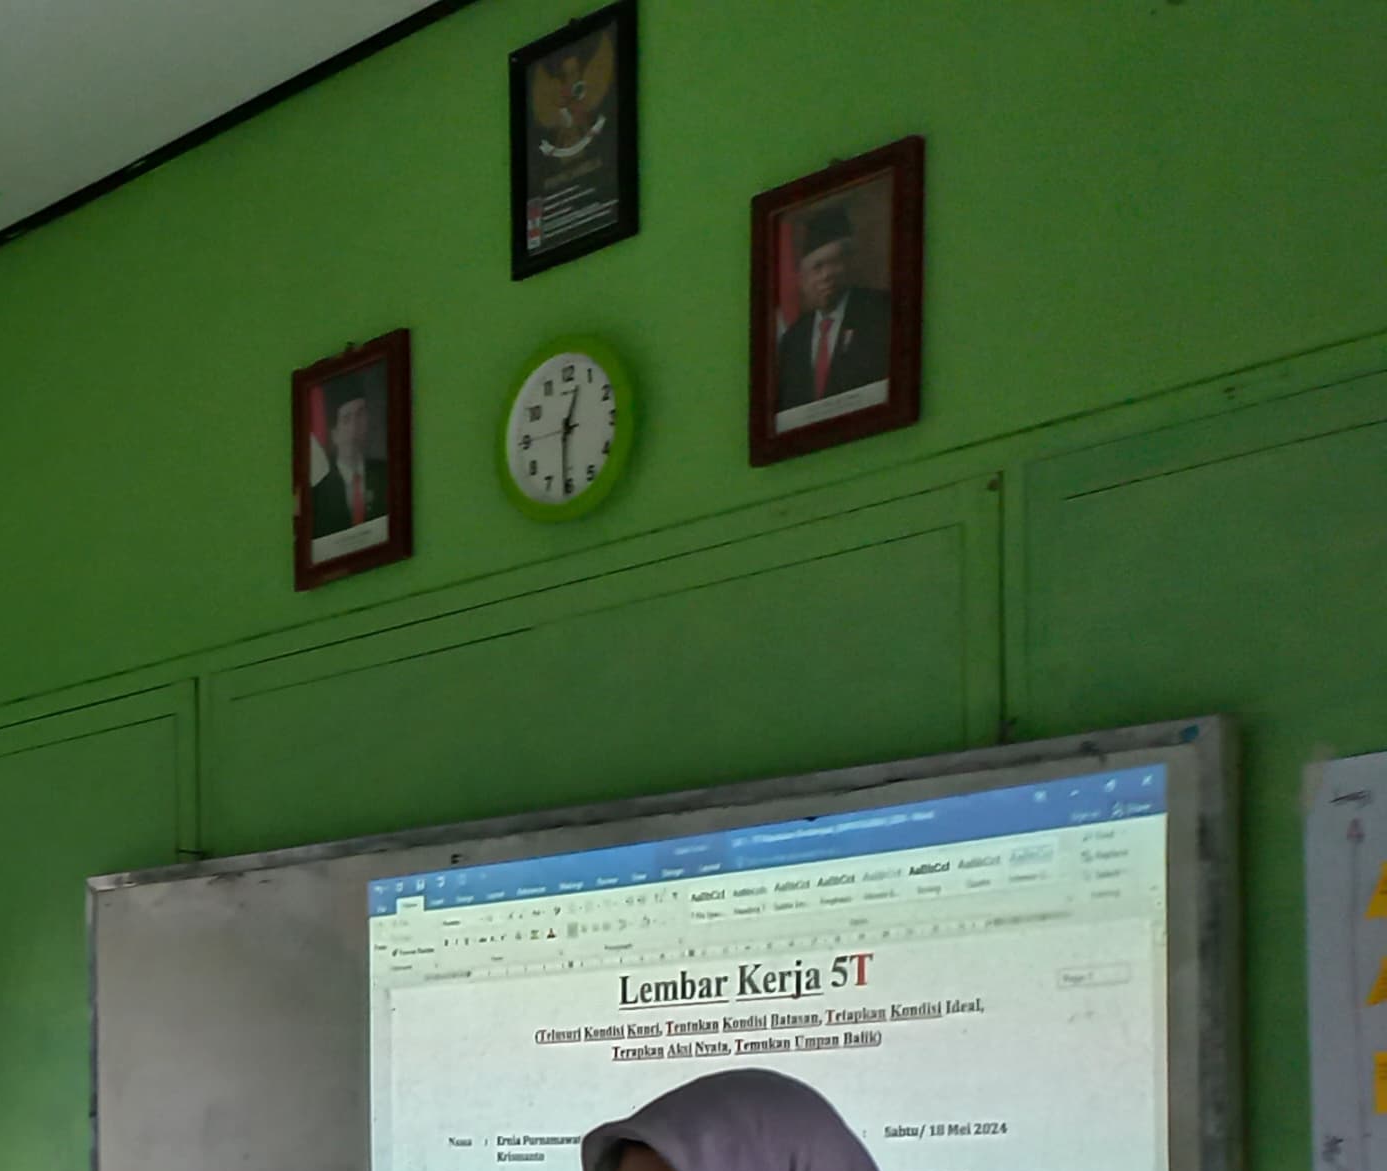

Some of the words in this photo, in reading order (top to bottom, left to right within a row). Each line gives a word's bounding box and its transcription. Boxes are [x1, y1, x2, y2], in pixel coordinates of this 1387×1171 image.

[619, 971, 728, 1008] Lembar
[737, 960, 822, 999] Kerja
[831, 953, 875, 988] 5T
[584, 1024, 625, 1041] Kondisi
[665, 1019, 719, 1036] Tentukan
[723, 1015, 767, 1032] Kondisi
[825, 1008, 887, 1025] Tetapkan
[890, 1001, 942, 1021] Kondisi
[946, 998, 985, 1014] Ideal,
[612, 1045, 664, 1060] Terapkan
[734, 1037, 791, 1055] Temukan
[974, 1122, 1008, 1135] 2024
